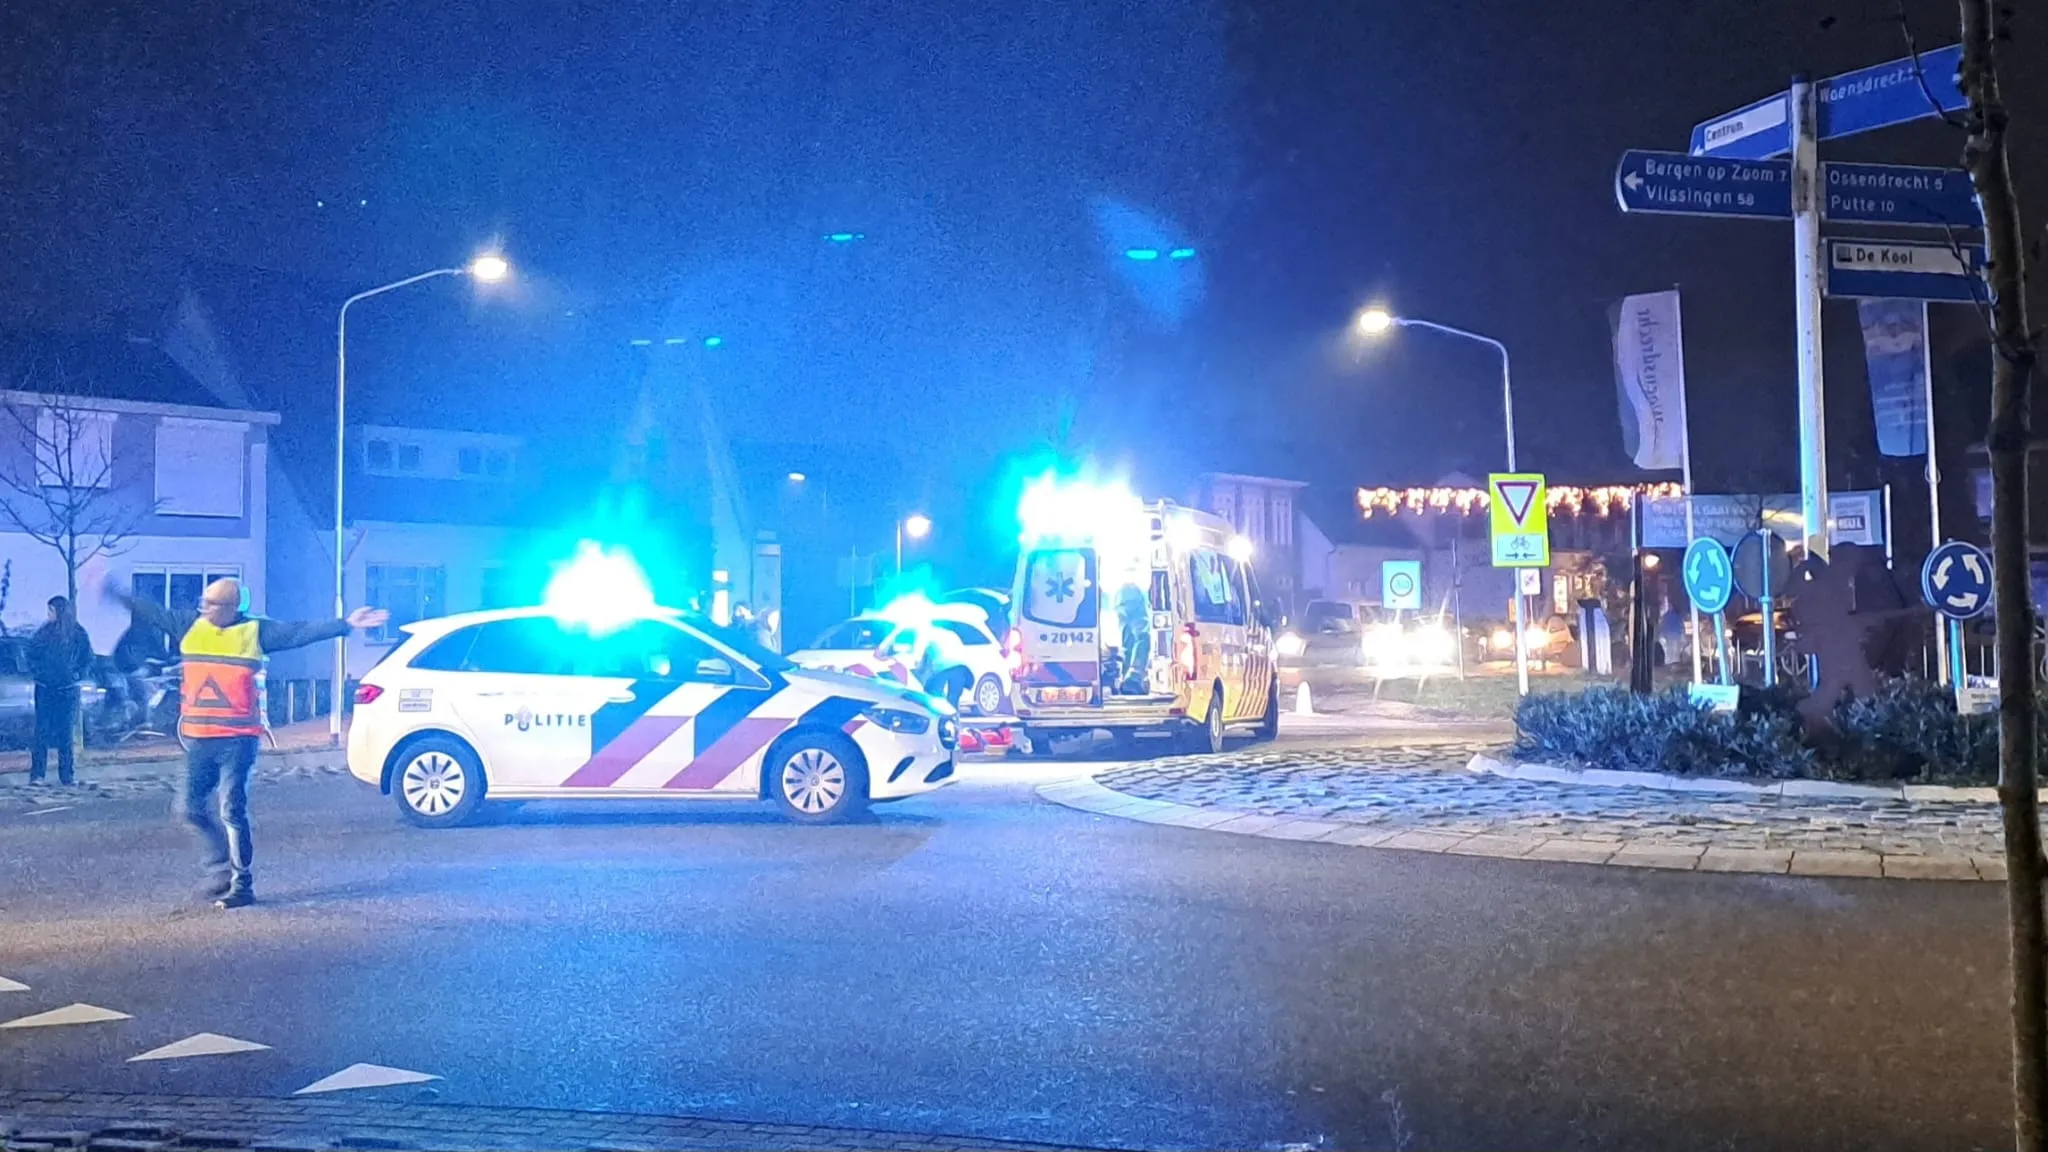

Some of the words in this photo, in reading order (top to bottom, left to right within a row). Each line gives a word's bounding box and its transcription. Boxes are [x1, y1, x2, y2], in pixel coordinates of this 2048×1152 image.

[1706, 119, 1744, 142] Centrum
[1645, 158, 1702, 181] Bergen
[1707, 166, 1726, 181] op
[1731, 163, 1774, 181] Zoom
[1829, 170, 1929, 190] Ossendrecht
[1645, 184, 1732, 208] Vlissingen
[1831, 194, 1876, 212] Putte
[1881, 200, 1896, 213] 10
[1856, 247, 1875, 262] De
[1881, 248, 1913, 264] Kool
[1051, 631, 1094, 644] 20142
[504, 707, 586, 731] POLITIE
